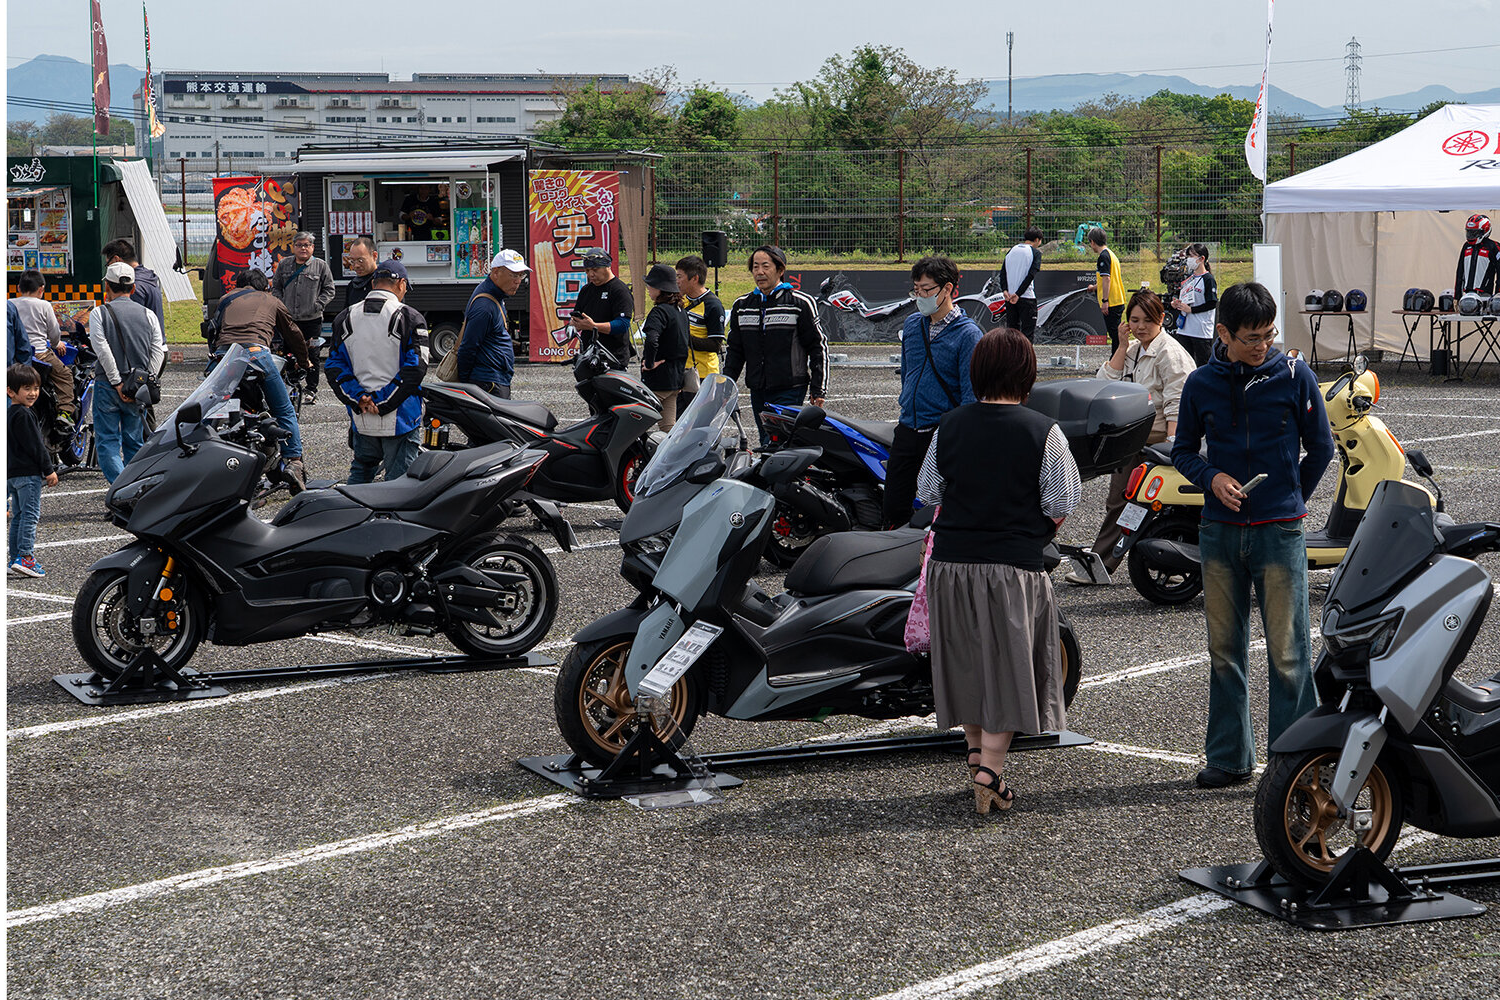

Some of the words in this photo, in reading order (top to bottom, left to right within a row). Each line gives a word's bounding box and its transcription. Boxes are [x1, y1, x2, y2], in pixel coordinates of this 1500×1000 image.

[186, 82, 267, 93] 熊本交通運輸
[533, 177, 565, 192] 驚きの
[539, 188, 569, 203] ロング
[554, 195, 584, 210] サイズ
[539, 347, 564, 356] LONG
[658, 618, 675, 640] YAMAHA
